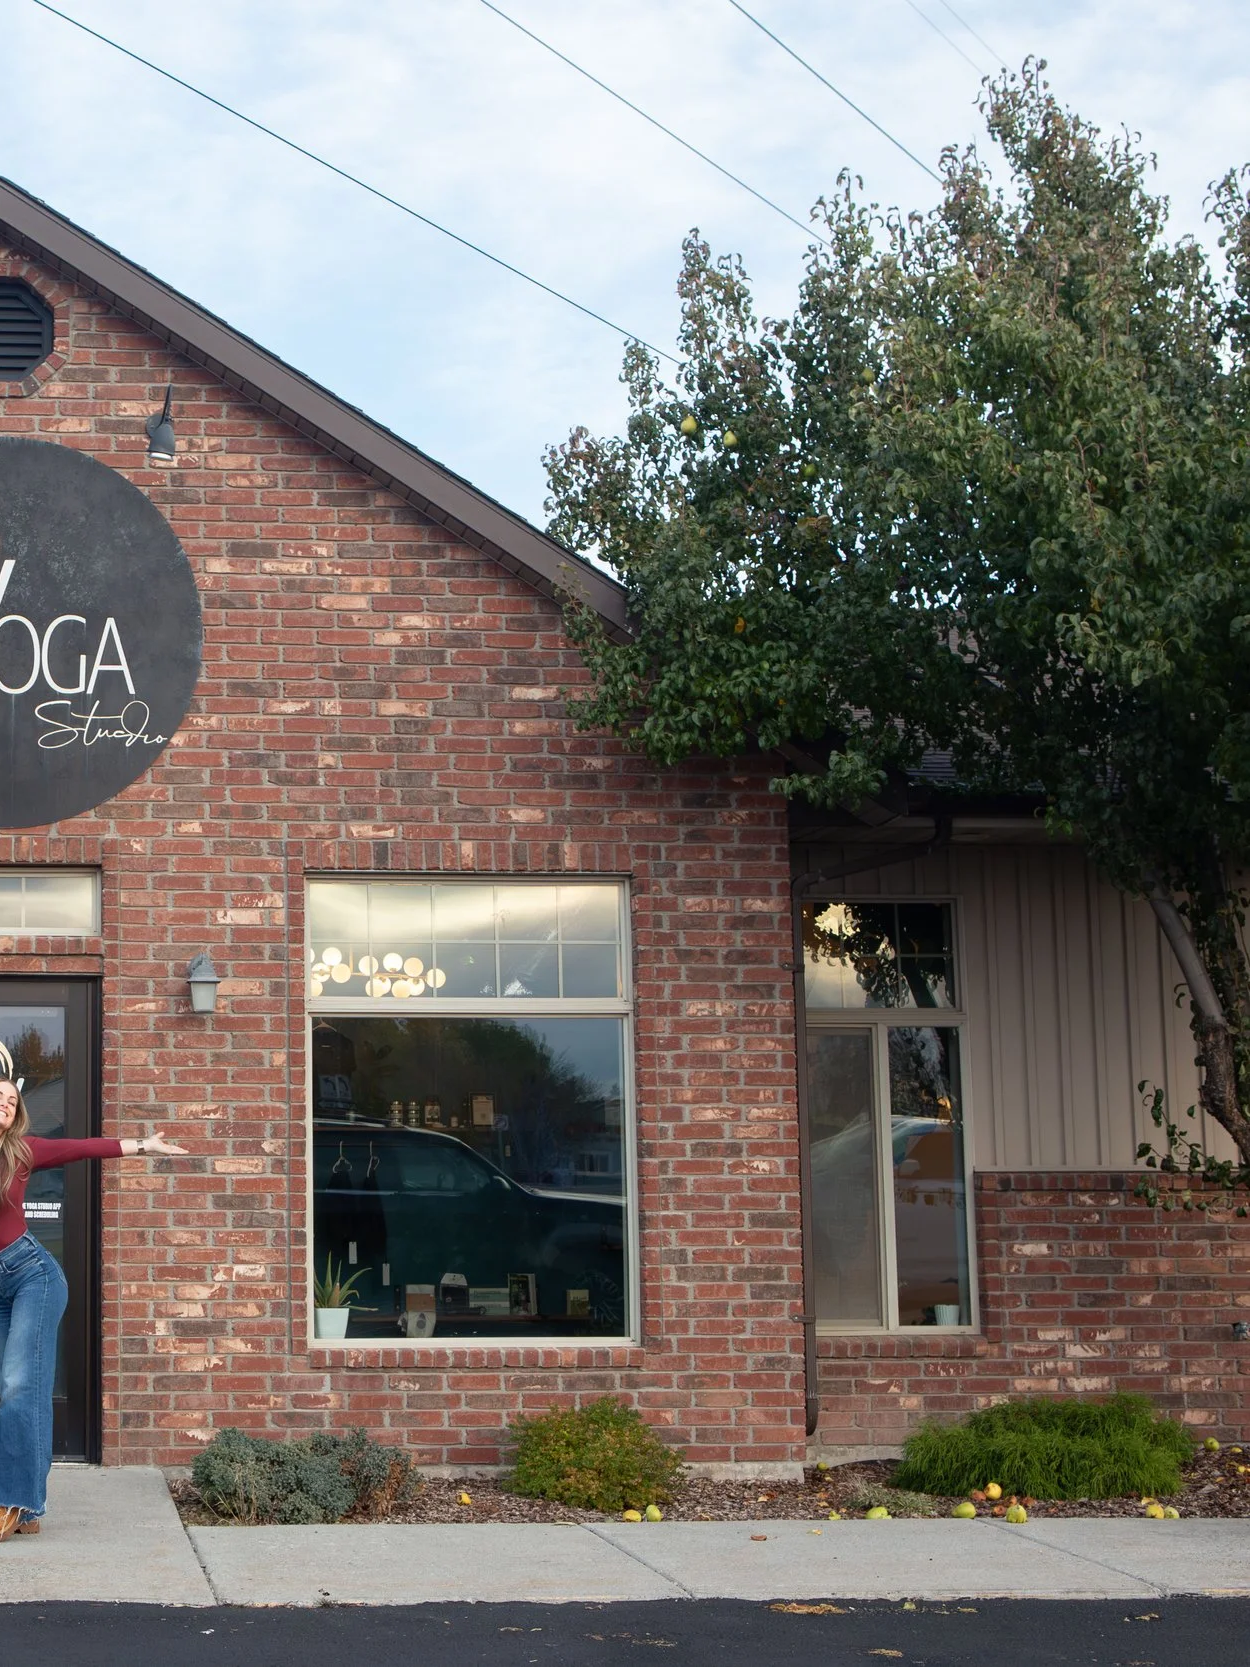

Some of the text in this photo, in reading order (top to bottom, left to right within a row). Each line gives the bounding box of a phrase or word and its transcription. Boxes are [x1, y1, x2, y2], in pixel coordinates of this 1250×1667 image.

[35, 700, 168, 749] Studio
[38, 1202, 53, 1210] STUDIO
[53, 1202, 61, 1210] APP
